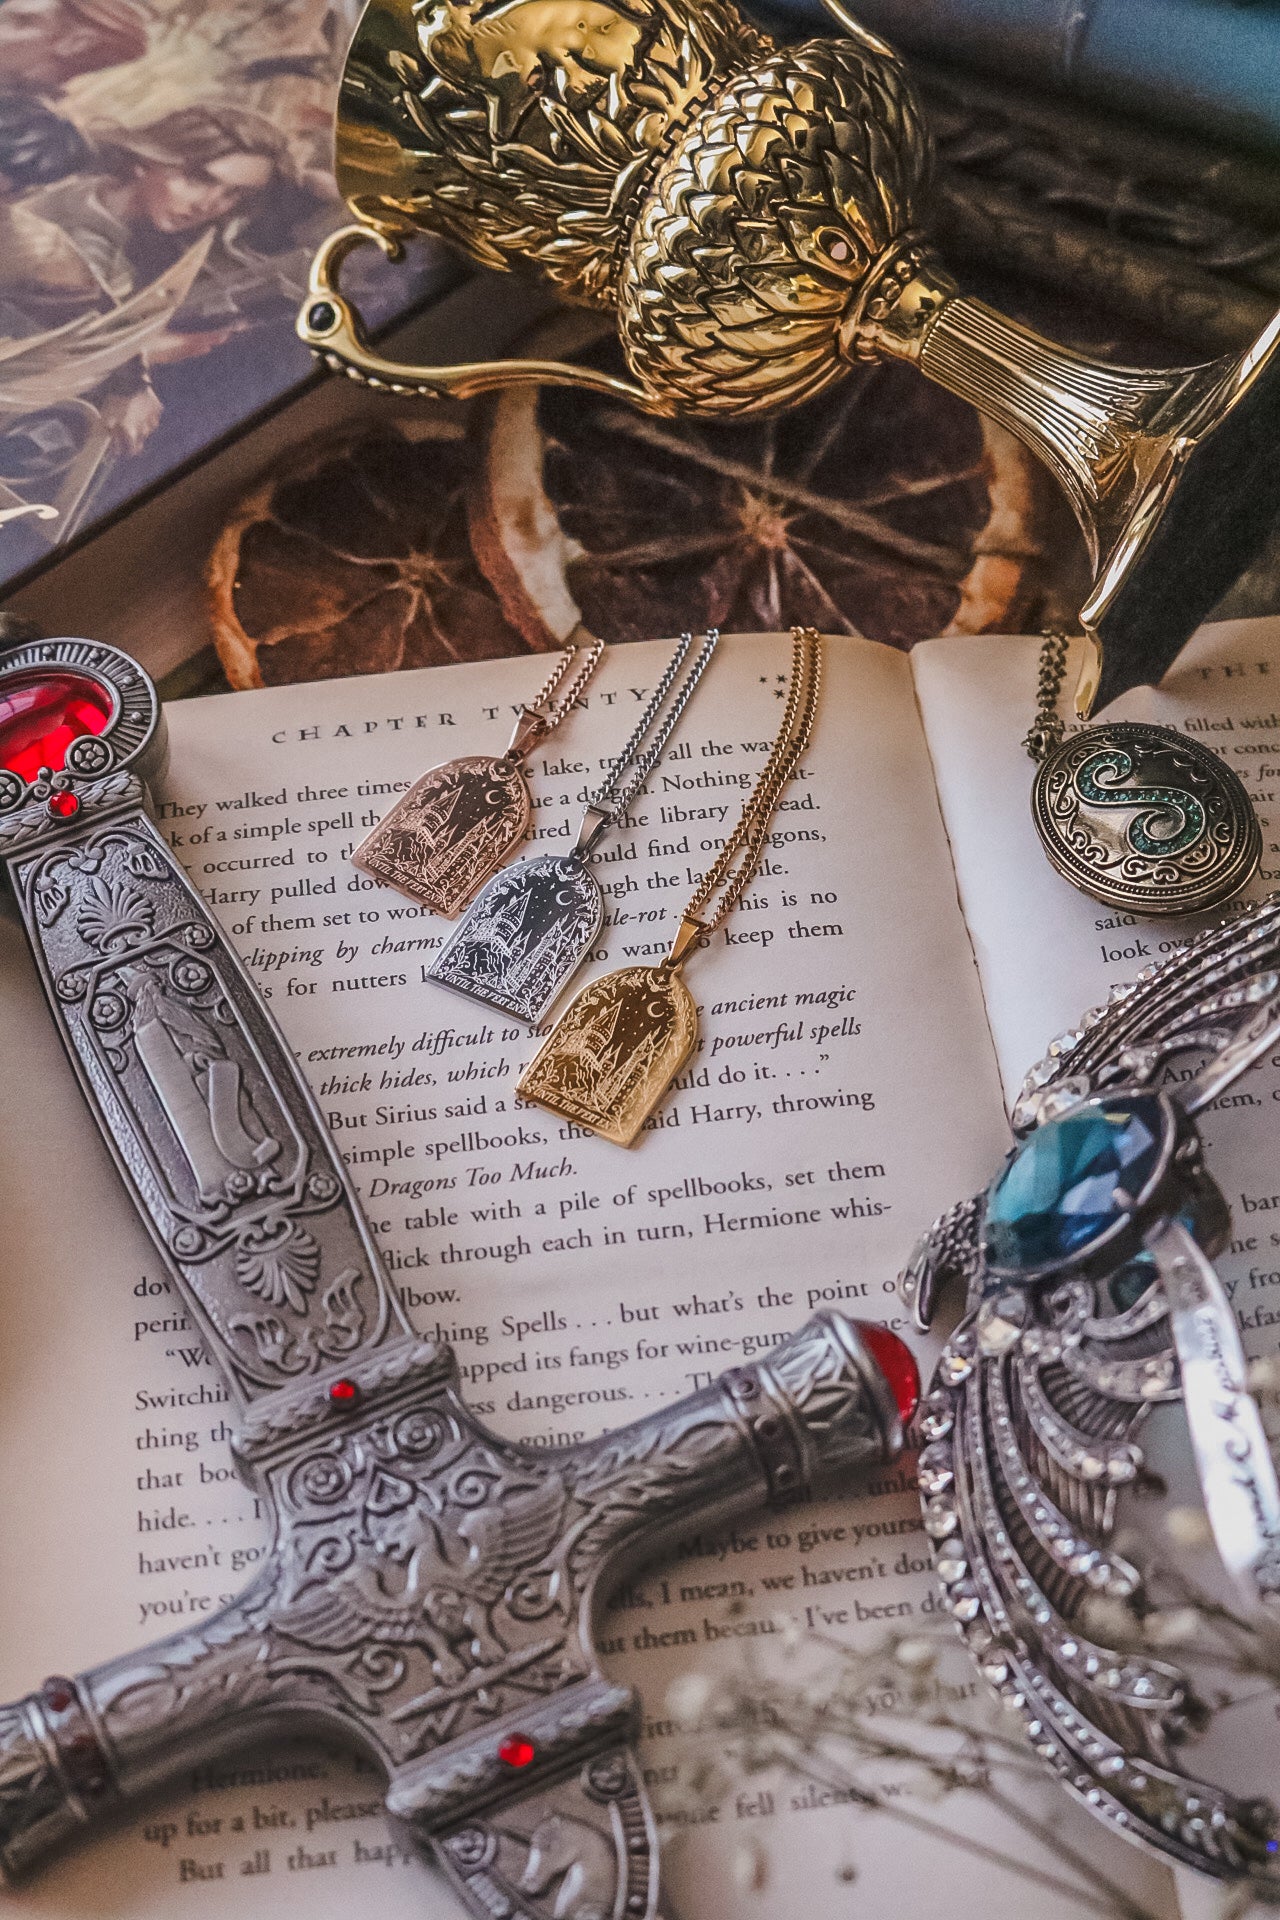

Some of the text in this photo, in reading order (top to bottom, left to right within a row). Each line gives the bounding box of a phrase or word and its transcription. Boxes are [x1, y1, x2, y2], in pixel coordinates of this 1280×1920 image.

[272, 712, 457, 744] CHAPTER
[1184, 716, 1234, 732] filled
[158, 801, 208, 820] They
[216, 788, 287, 811] walked
[297, 785, 349, 802] three
[357, 779, 411, 797] times
[543, 758, 590, 776] lake,
[668, 743, 692, 761] all
[701, 740, 733, 757] the
[190, 826, 213, 846] of
[216, 829, 228, 842] a
[234, 817, 302, 841] simple
[308, 812, 354, 836] spell
[361, 810, 381, 827] th
[559, 794, 570, 805] a
[662, 770, 751, 792] Nothing
[201, 836, 726, 906] Harry pulled dow ould find on
[203, 848, 294, 874] occurred
[307, 851, 328, 864] to
[617, 811, 649, 829] the
[660, 805, 729, 824] library
[232, 915, 257, 935] of
[261, 913, 315, 933] them
[323, 911, 351, 927] set
[359, 909, 381, 923] to
[387, 903, 436, 920] wor
[646, 870, 681, 889] the
[686, 867, 737, 887] lage
[336, 940, 359, 963] by
[371, 935, 444, 956] charms
[781, 890, 798, 907] is
[810, 891, 838, 905] no
[287, 978, 318, 997] for
[332, 970, 407, 992] nutters
[724, 928, 774, 948] keep
[788, 920, 844, 939] them
[1100, 936, 1195, 964] look ove
[307, 1035, 405, 1062] extremely
[411, 1024, 495, 1056] difficult
[501, 1025, 520, 1043] to
[711, 992, 788, 1016] ancient
[794, 984, 857, 1009] magic
[320, 1071, 372, 1096] thick
[379, 1067, 437, 1090] hides,
[447, 1057, 510, 1084] which
[711, 1022, 803, 1056] powerful
[809, 1016, 862, 1044] spells
[327, 1111, 368, 1131] But
[375, 1105, 438, 1126] Sirius
[445, 1095, 488, 1118] said
[495, 1099, 507, 1113] a
[718, 1065, 746, 1084] do
[342, 1089, 876, 1166] simple spellbooks, aid Harry, throwing
[369, 1156, 578, 1199] Dragons Too Much.
[405, 1160, 886, 1231] table with a pile of spellbooks, set them
[440, 1235, 531, 1263] through
[542, 1228, 592, 1252] each
[603, 1226, 625, 1246] in
[637, 1223, 693, 1242] turn,
[703, 1207, 821, 1235] Hermione
[830, 1197, 893, 1220] whis-
[501, 1279, 868, 1340] Spells but what’s the point
[1249, 1267, 1280, 1290] fro
[134, 1286, 461, 1341] peri lbow.
[135, 1332, 795, 1411] Switchi apped its fangs for wine-gum
[136, 1386, 634, 1452] thing th dangerous.
[136, 1468, 184, 1490] that
[766, 1532, 791, 1549] to
[797, 1523, 846, 1552] give
[660, 1581, 672, 1604] I
[680, 1579, 754, 1603] mean,
[761, 1573, 796, 1591] we
[633, 1625, 697, 1651] them
[704, 1618, 776, 1642] becau
[855, 1600, 913, 1623] been
[143, 1820, 178, 1847] up
[186, 1811, 223, 1838] for
[230, 1814, 246, 1832] a
[306, 1798, 381, 1831] please
[179, 1857, 226, 1883] But
[240, 1849, 272, 1876] all
[286, 1845, 338, 1872] that
[735, 1790, 775, 1819] fell
